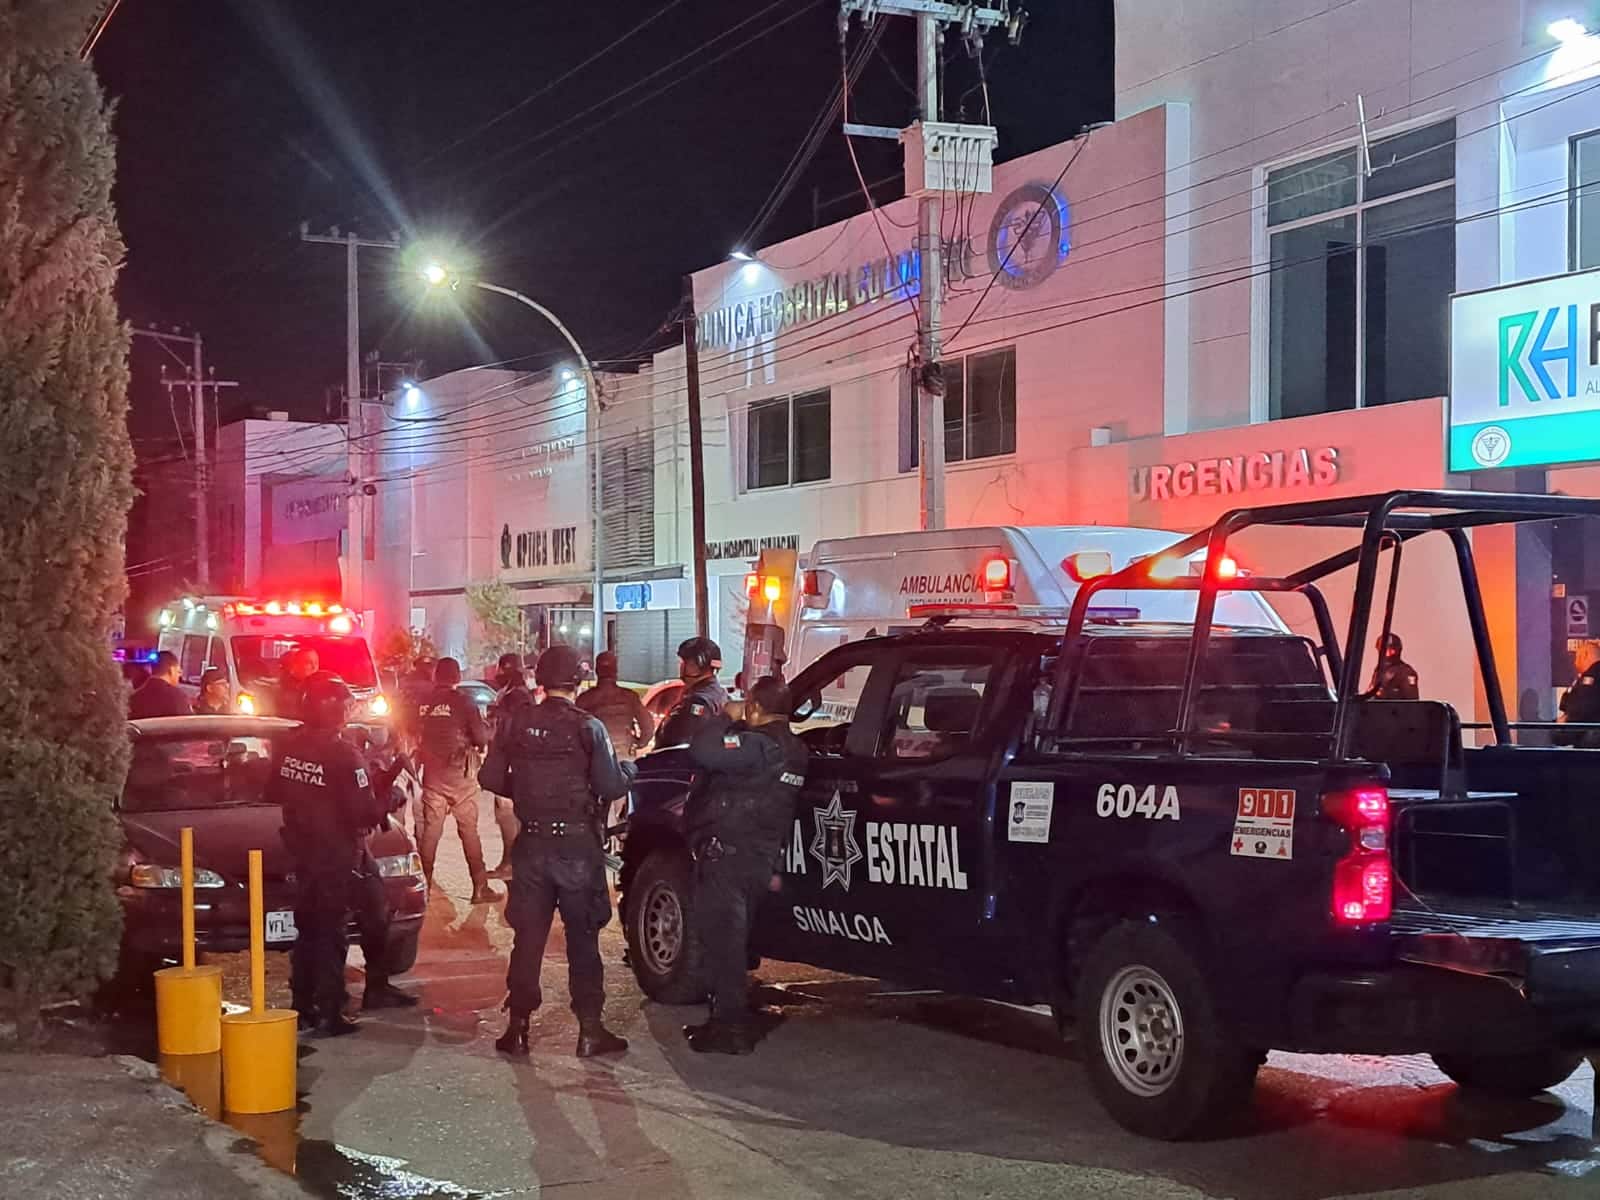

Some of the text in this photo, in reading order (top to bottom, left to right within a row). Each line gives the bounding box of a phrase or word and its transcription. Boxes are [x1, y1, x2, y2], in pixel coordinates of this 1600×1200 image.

[695, 301, 756, 352] CLINICA
[759, 270, 848, 337] HOSPITAL
[1129, 447, 1339, 502] URGENCIAS
[552, 526, 576, 566] WEST
[900, 573, 985, 595] AMBULANCIA
[280, 766, 327, 787] ESTATAL
[284, 755, 324, 776] POLICIA
[1096, 783, 1181, 820] 604A
[1243, 793, 1289, 815] 911
[1234, 826, 1291, 839] EMERGENCIAS
[865, 821, 968, 890] ESTATAL
[792, 905, 893, 945] SINALOA
